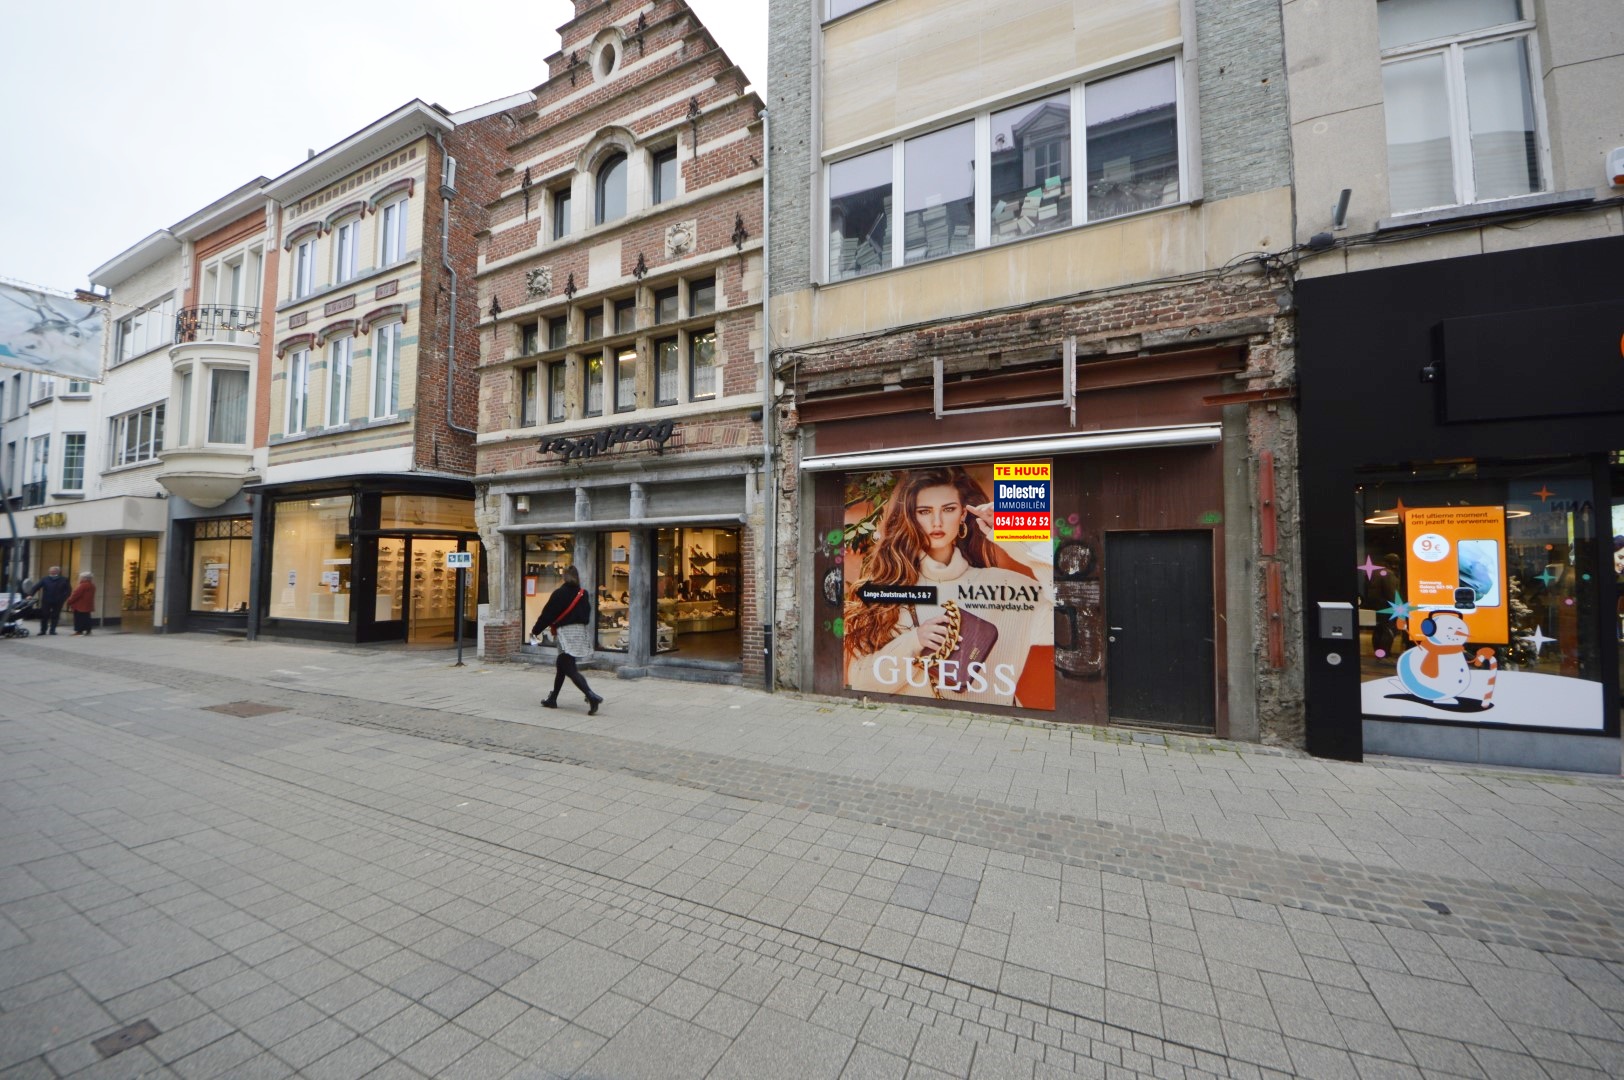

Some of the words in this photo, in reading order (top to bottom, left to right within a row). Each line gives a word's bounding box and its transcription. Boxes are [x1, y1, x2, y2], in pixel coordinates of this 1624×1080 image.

[537, 419, 674, 459] TORNADO
[1421, 540, 1432, 551] 9
[864, 591, 879, 599] Lange
[908, 591, 917, 599] 1a,
[958, 585, 1042, 601] MAYDAY
[873, 655, 1016, 696] GUESS
